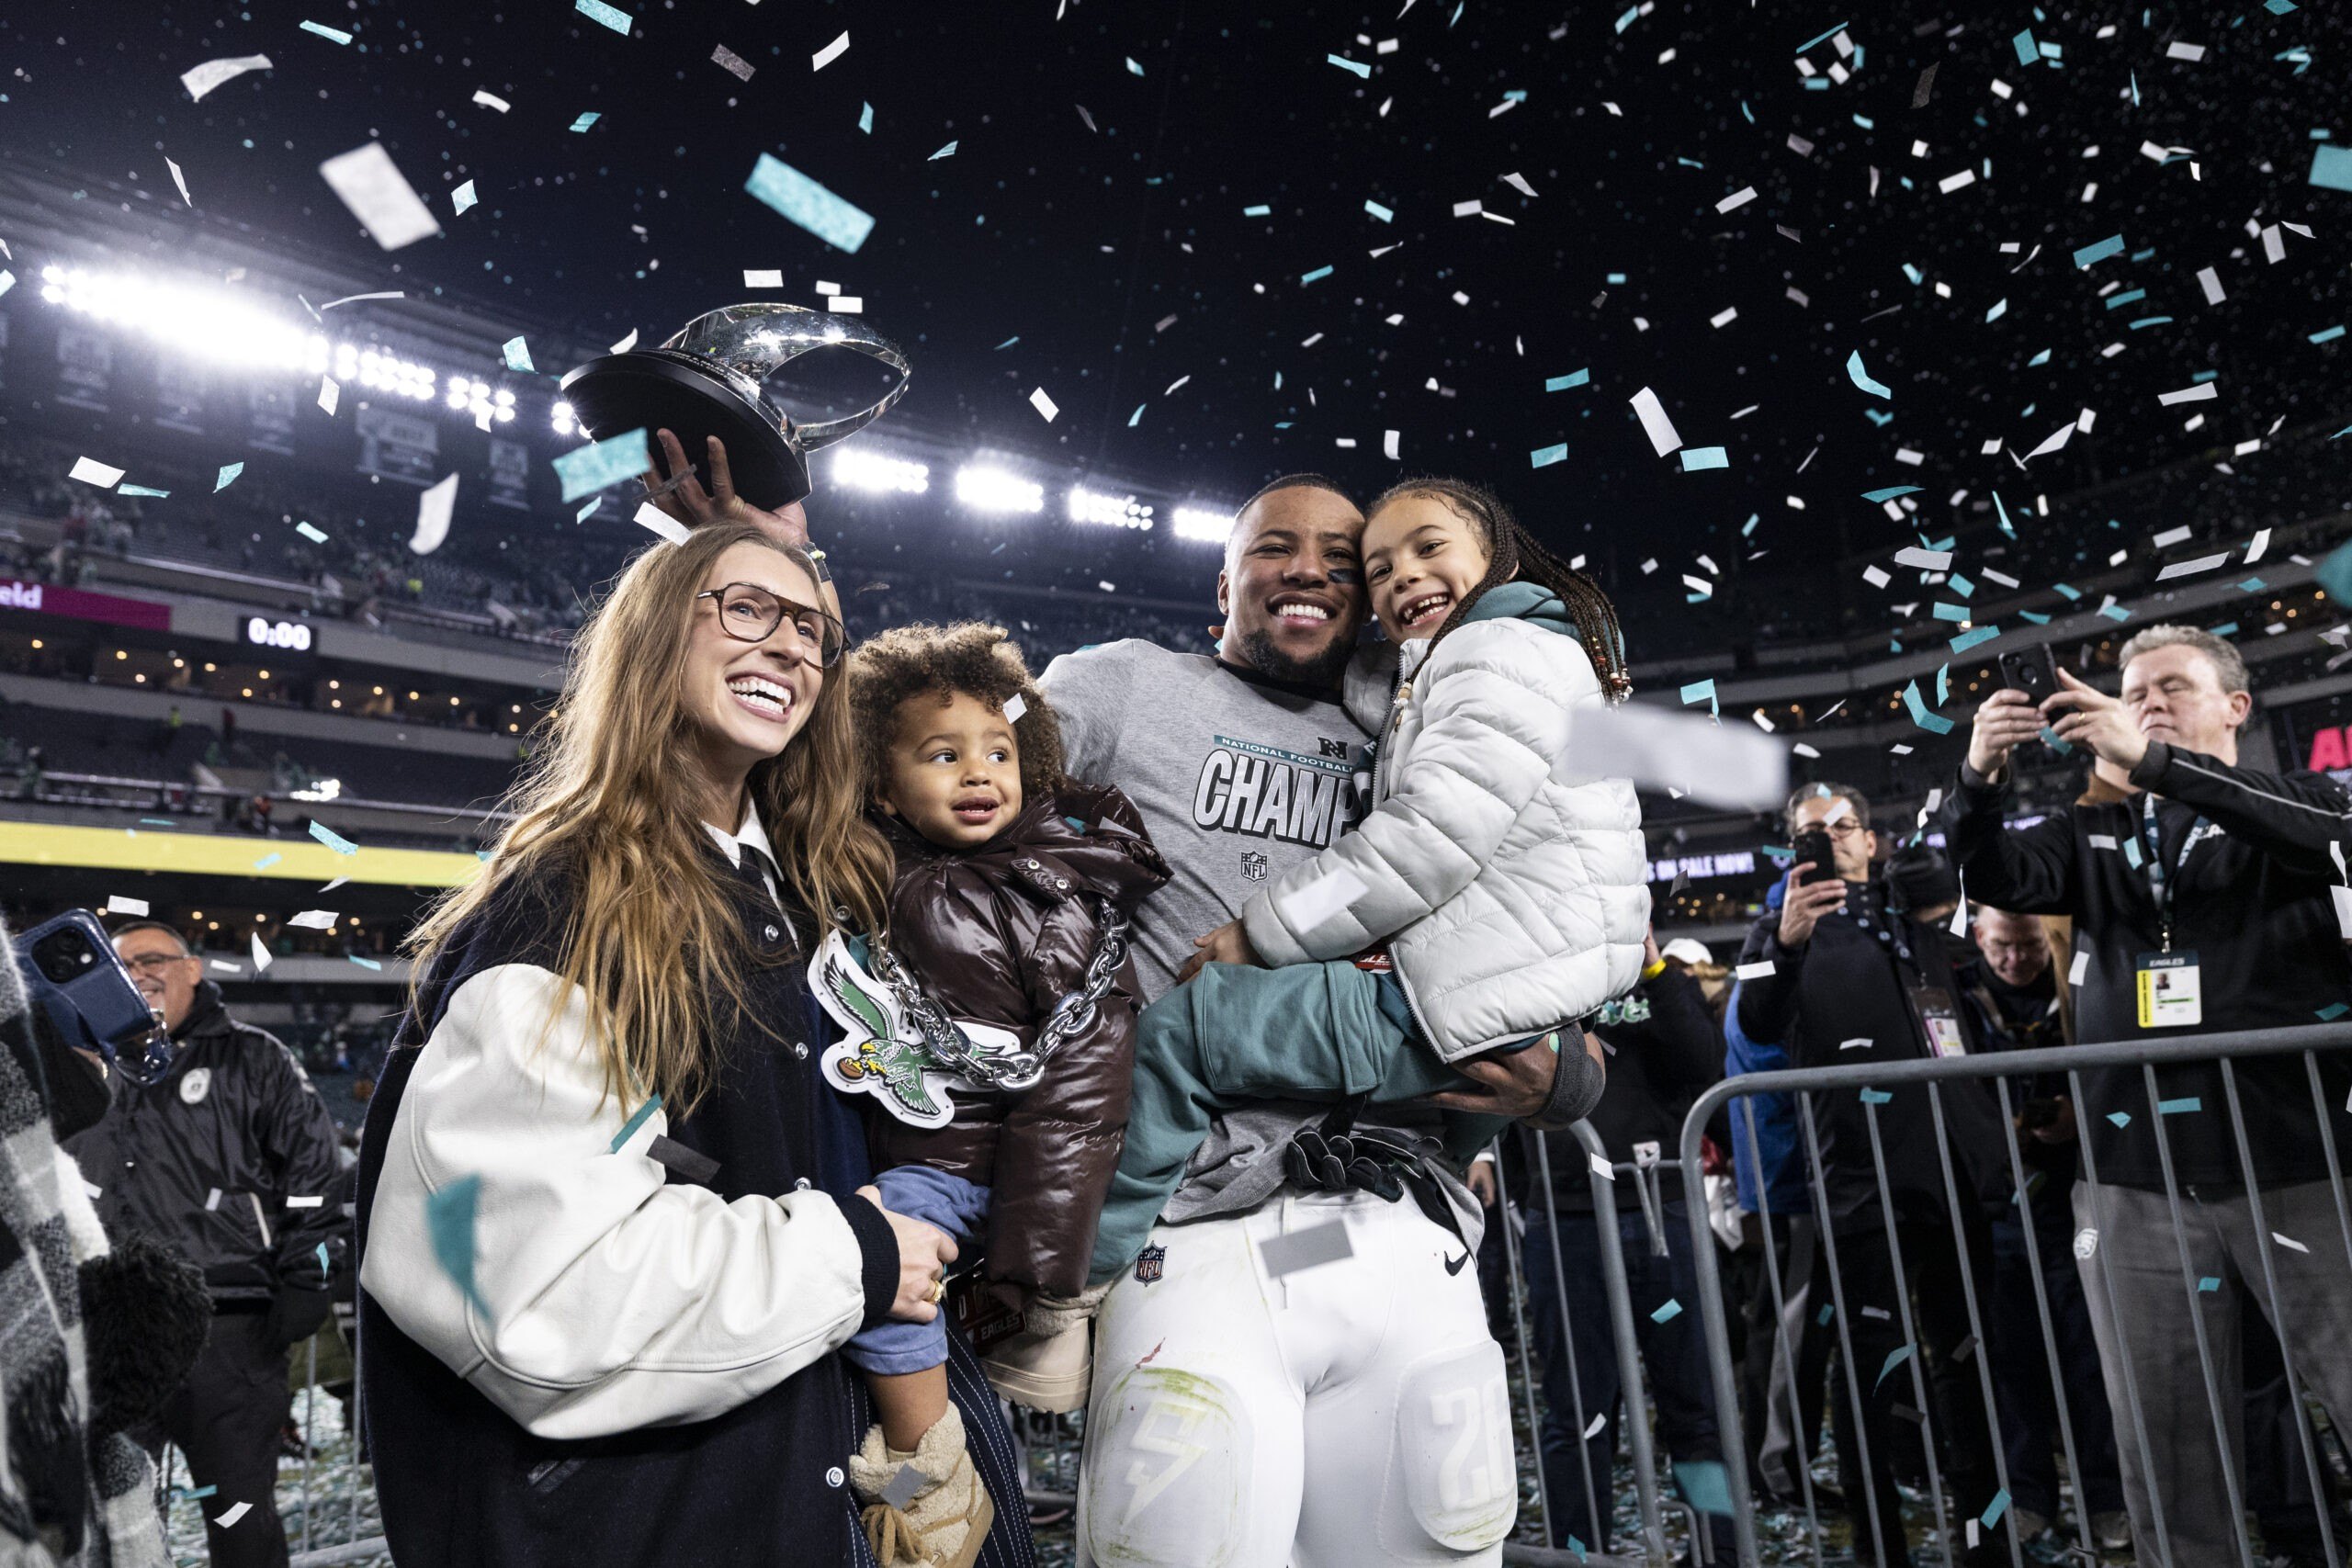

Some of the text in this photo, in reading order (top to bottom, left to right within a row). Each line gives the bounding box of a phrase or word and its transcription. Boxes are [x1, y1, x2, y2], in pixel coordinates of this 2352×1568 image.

[248, 616, 311, 651] 0:00
[1222, 737, 1285, 759] NATIONAL
[1243, 862, 1266, 879] NFL
[1656, 859, 1678, 882] ON
[1679, 855, 1714, 878] SALE
[1138, 1260, 1162, 1279] NFL
[980, 1314, 1020, 1340] EAGLES
